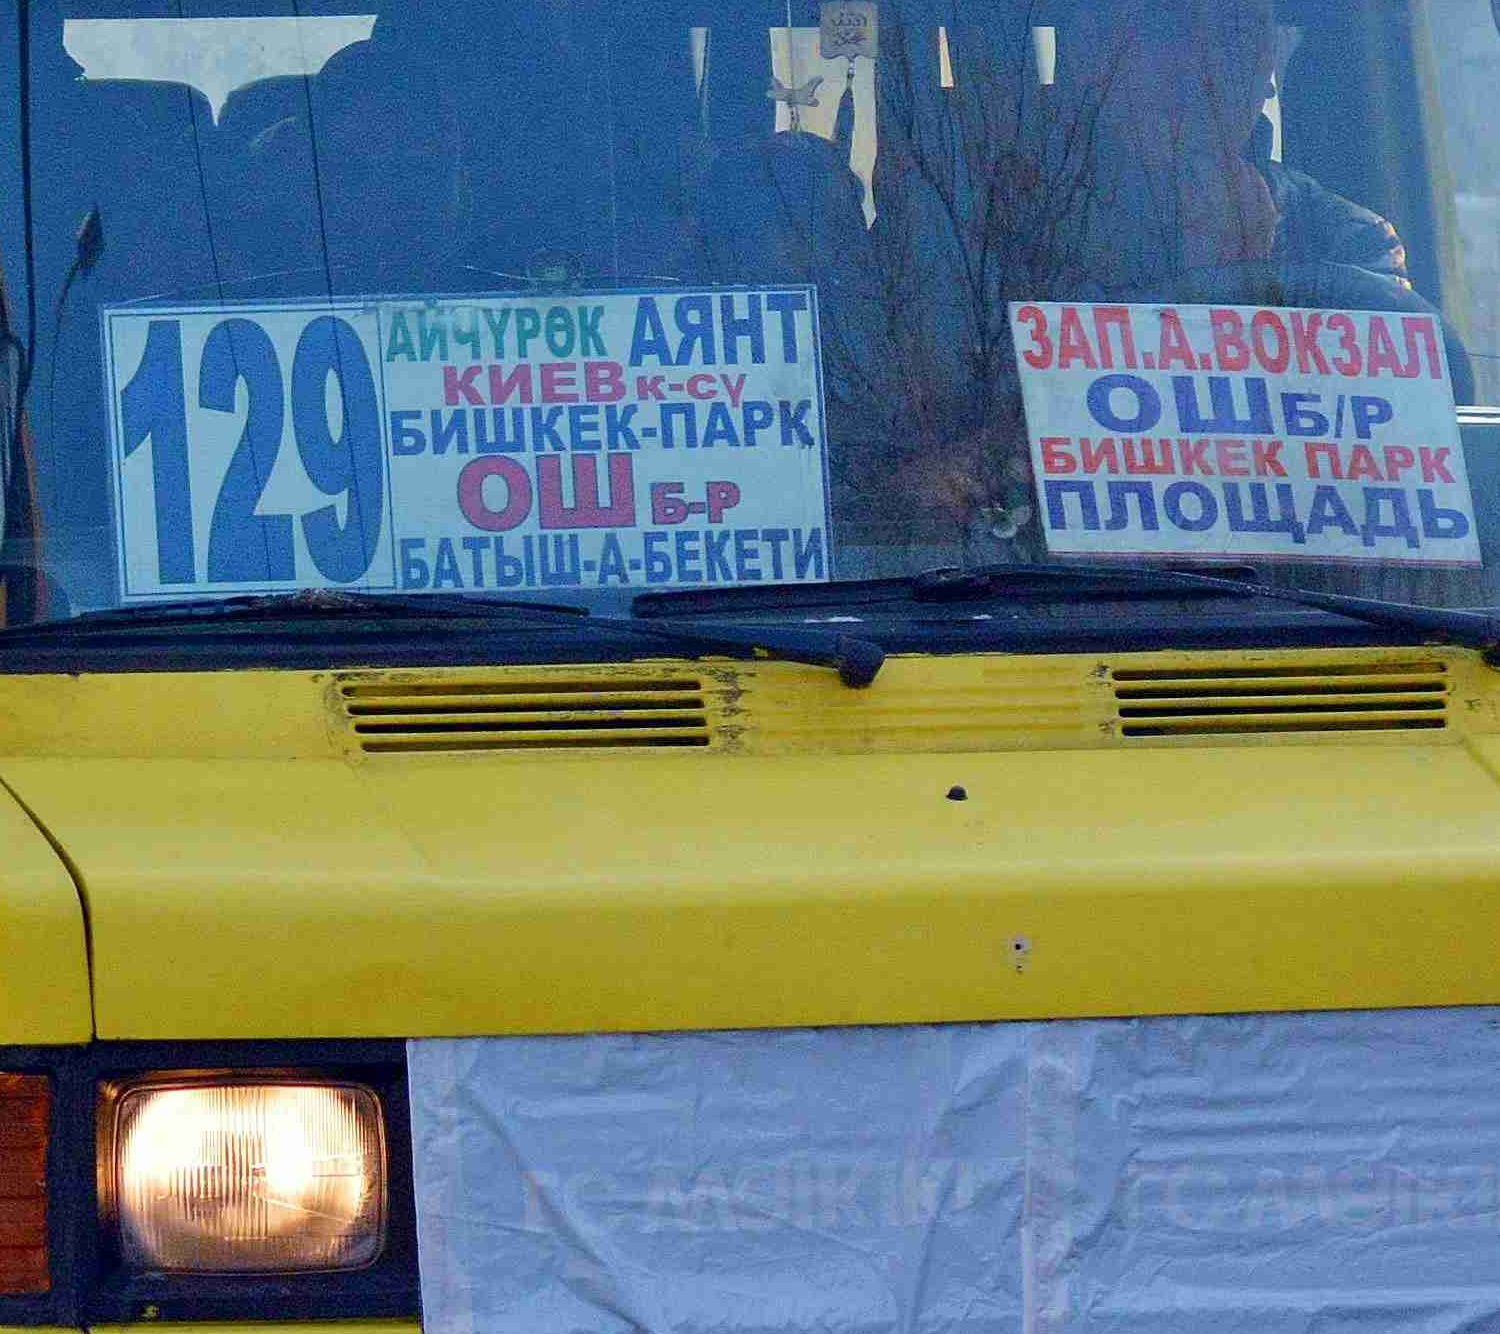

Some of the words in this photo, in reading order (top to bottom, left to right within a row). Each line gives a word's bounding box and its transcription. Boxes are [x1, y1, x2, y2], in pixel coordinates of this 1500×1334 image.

[628, 293, 807, 366] АЯНТ
[1015, 304, 1443, 380] ЗАП.А.ВОКЗАЛ
[443, 361, 627, 407] КИЕВ
[1086, 373, 1275, 436] ОШ
[1279, 391, 1394, 440] Б/Р
[119, 314, 384, 585] 129
[389, 398, 817, 457] БИШКЕК-ПАРК
[1039, 436, 1289, 478] БИШКЕК
[1303, 441, 1457, 484] ПАРК
[456, 452, 637, 532] ОШ
[650, 480, 742, 526] Б-Р
[1043, 479, 1471, 549] ПЛОЩАДЬ
[399, 527, 826, 589] БАТЫШ-А-БЕКЕТИ
